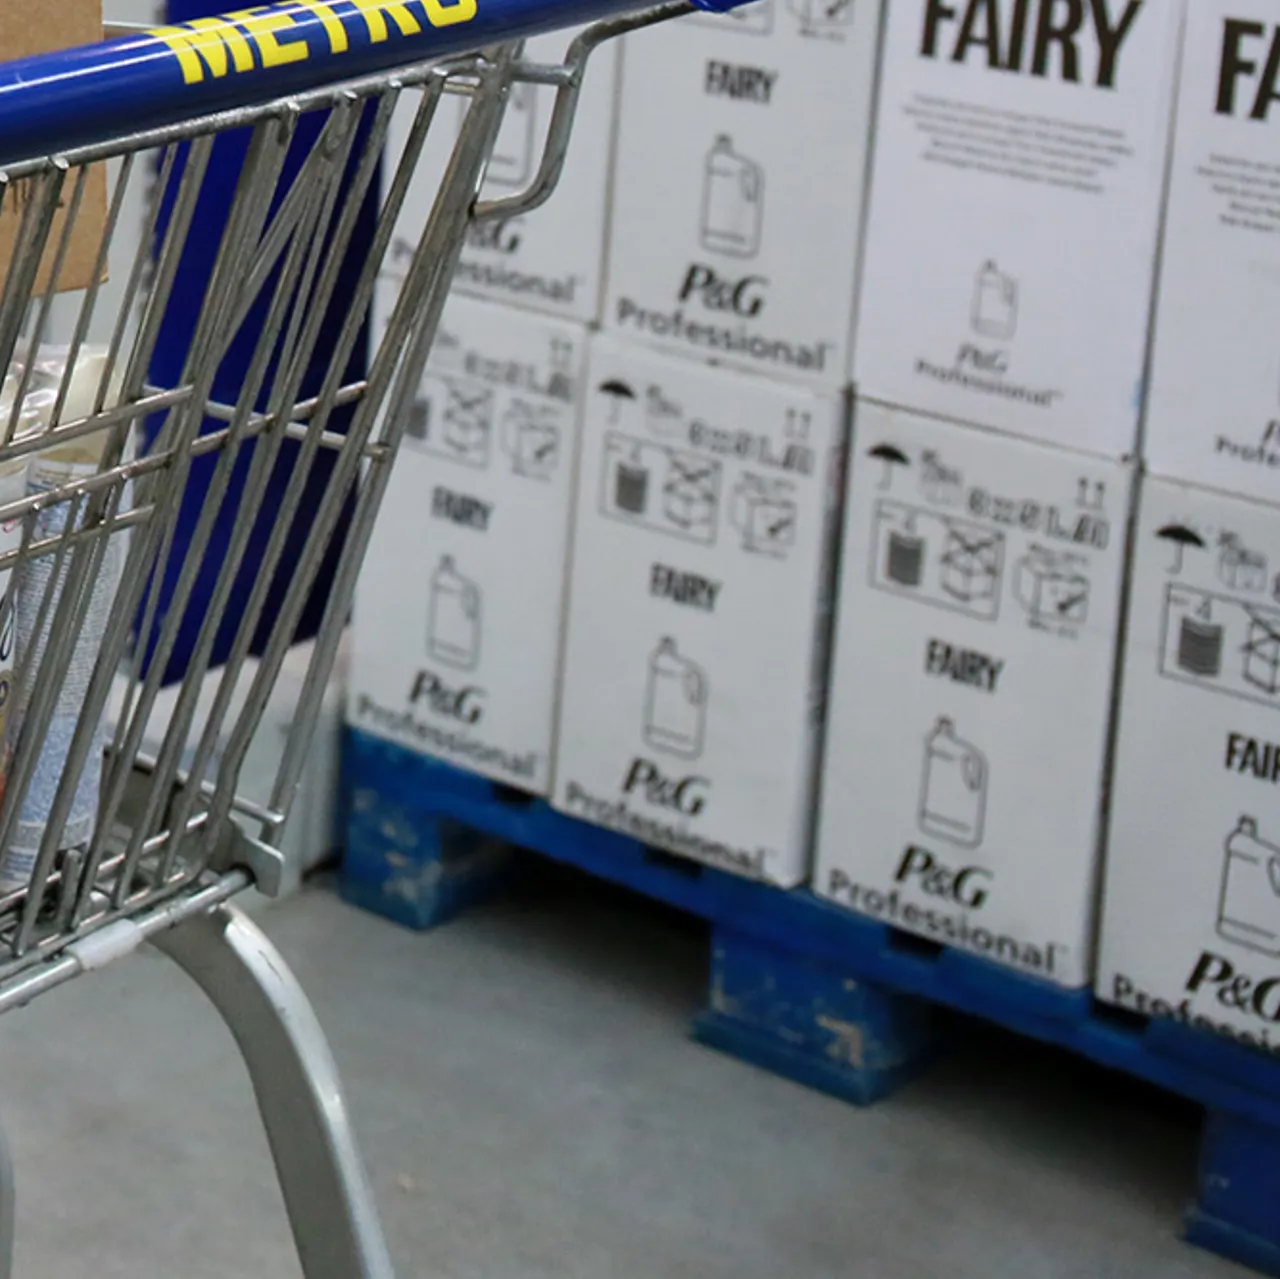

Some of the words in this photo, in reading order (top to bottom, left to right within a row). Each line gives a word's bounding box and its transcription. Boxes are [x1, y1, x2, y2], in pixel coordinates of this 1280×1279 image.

[705, 59, 778, 105] FAIRY
[676, 263, 771, 318] P&G
[617, 296, 828, 372] Professional
[429, 485, 495, 533] FAIRY
[650, 563, 724, 613] FAIRY
[924, 638, 1004, 695] FAIRY
[407, 669, 487, 726] P&G
[356, 692, 536, 780] Professional
[623, 757, 714, 818] P&G
[566, 780, 766, 873] Professional
[894, 843, 993, 911] P&G
[830, 867, 1057, 974] Professional
